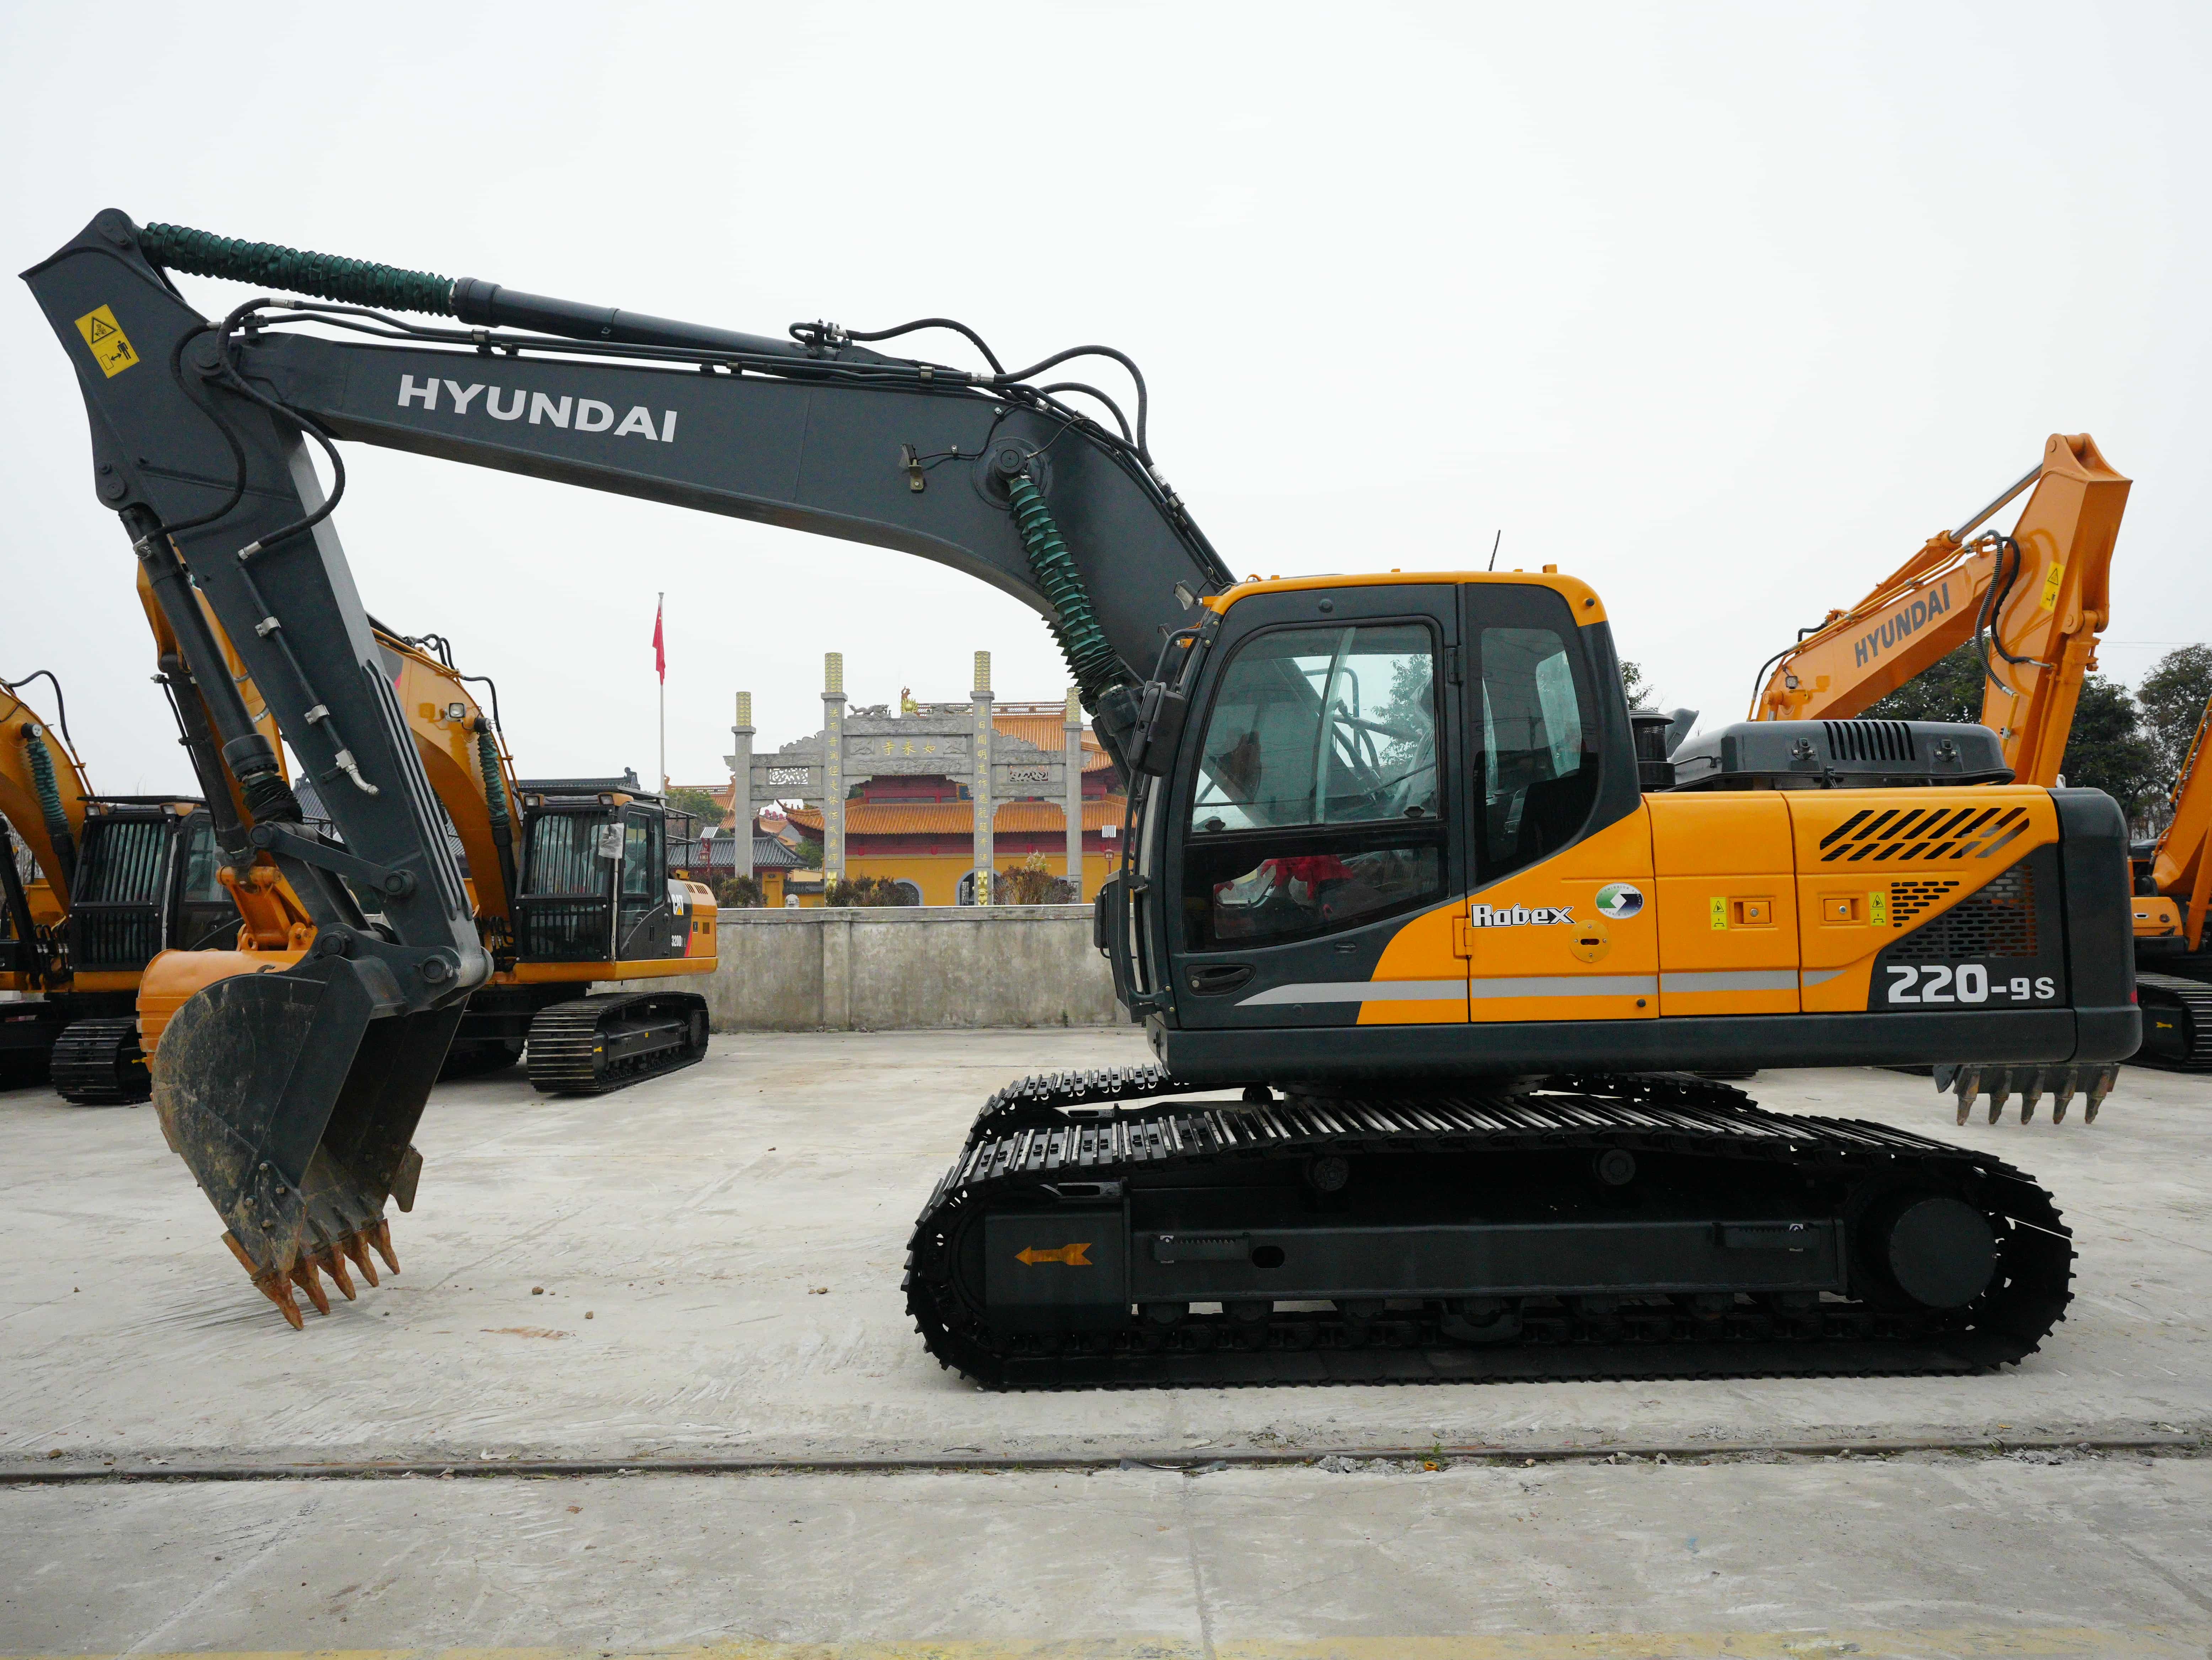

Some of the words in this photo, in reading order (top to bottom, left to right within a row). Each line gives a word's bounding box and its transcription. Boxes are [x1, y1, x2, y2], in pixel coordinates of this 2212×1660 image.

[397, 374, 677, 442] HYUNDAI
[1854, 582, 1950, 668] HYUNDAI
[671, 894, 684, 915] CAT
[1471, 903, 1577, 928] Robex
